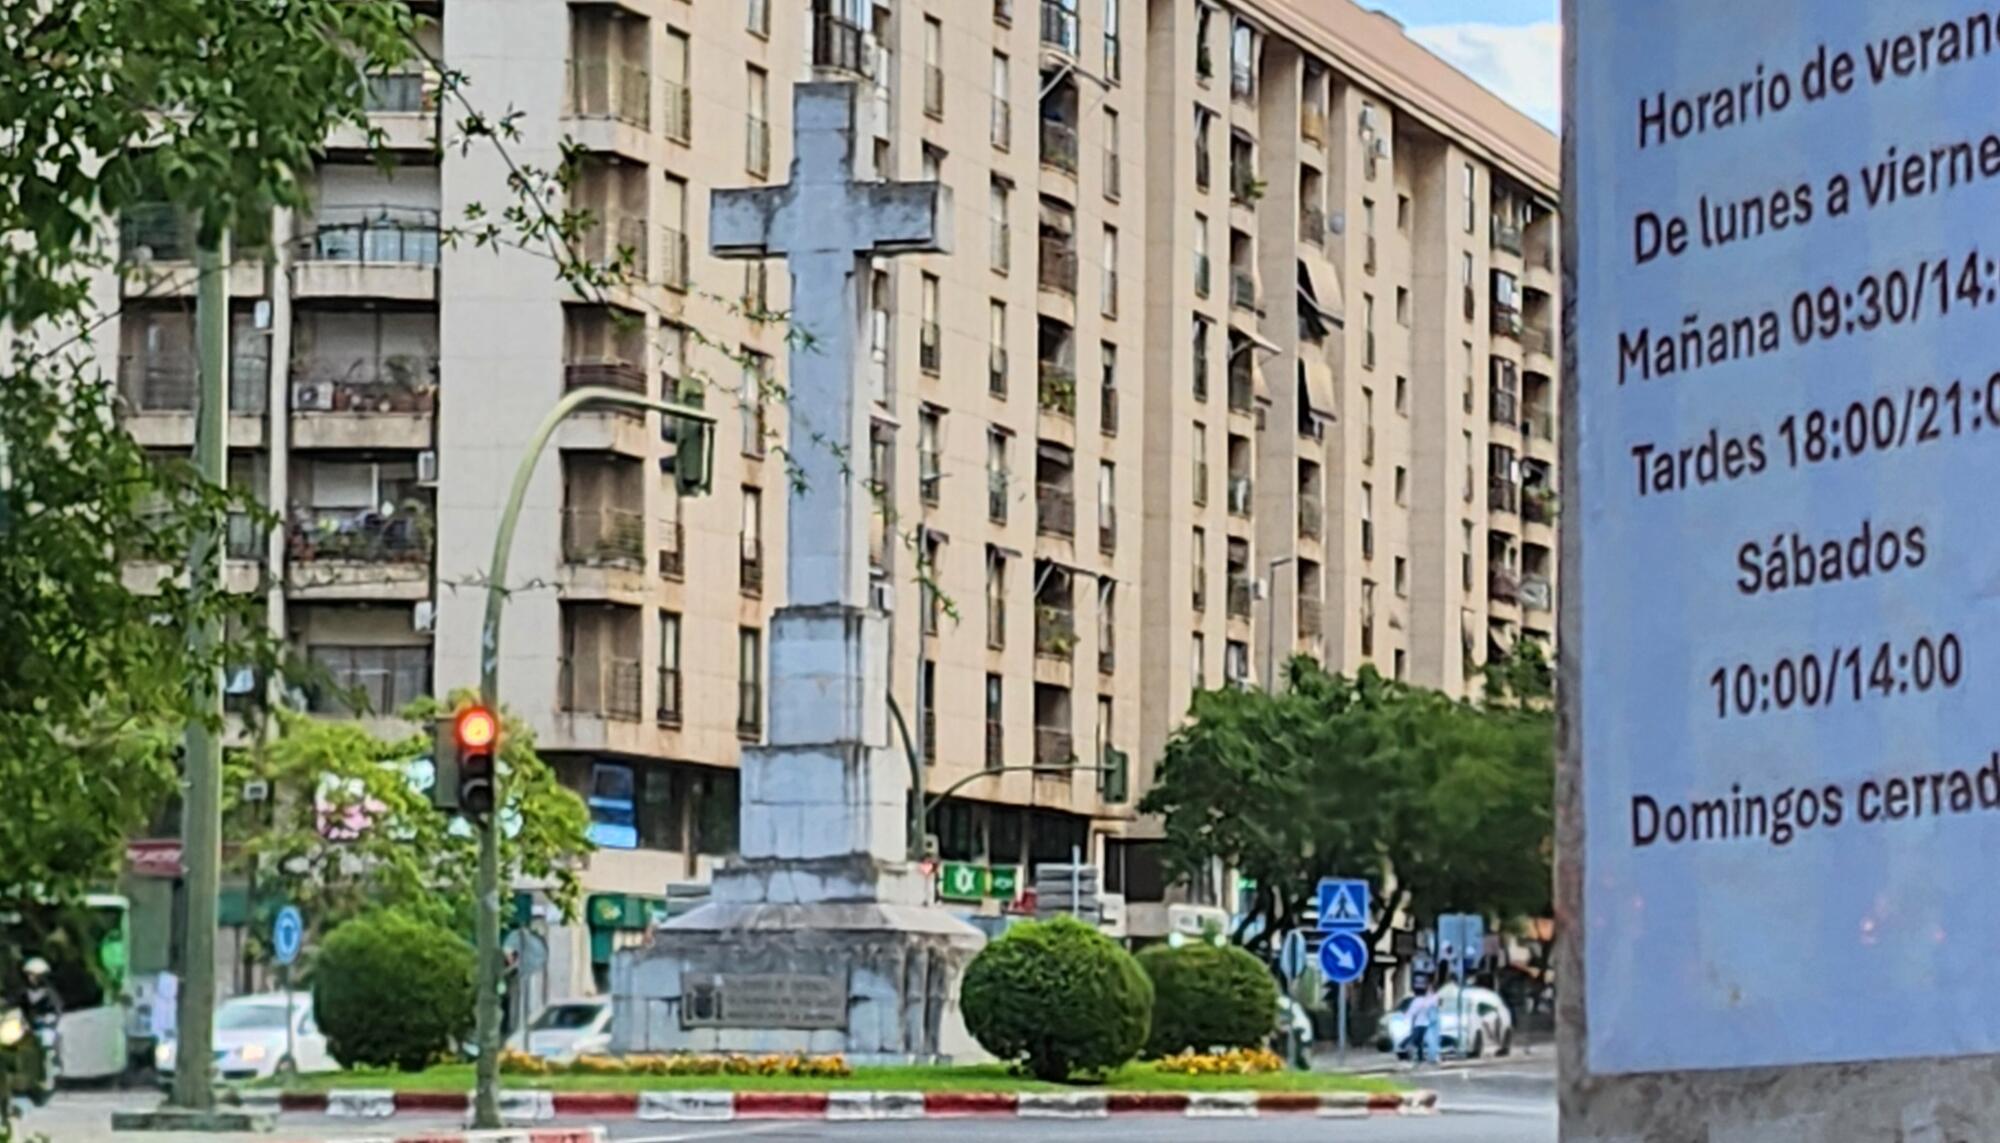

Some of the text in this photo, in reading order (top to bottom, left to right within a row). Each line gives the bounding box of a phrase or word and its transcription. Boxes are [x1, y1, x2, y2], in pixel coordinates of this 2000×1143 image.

[1637, 10, 2000, 150] Horario de veran
[1633, 210, 1689, 266] De
[1699, 183, 1813, 248] lunes
[1825, 172, 1850, 218] a
[1617, 311, 1781, 387] Mañana
[1631, 427, 1768, 498] Tardes
[1736, 519, 1927, 596] Sábados
[1709, 631, 1963, 719] 10:00/14:00
[1631, 750, 2000, 847] Domingos cerrad
